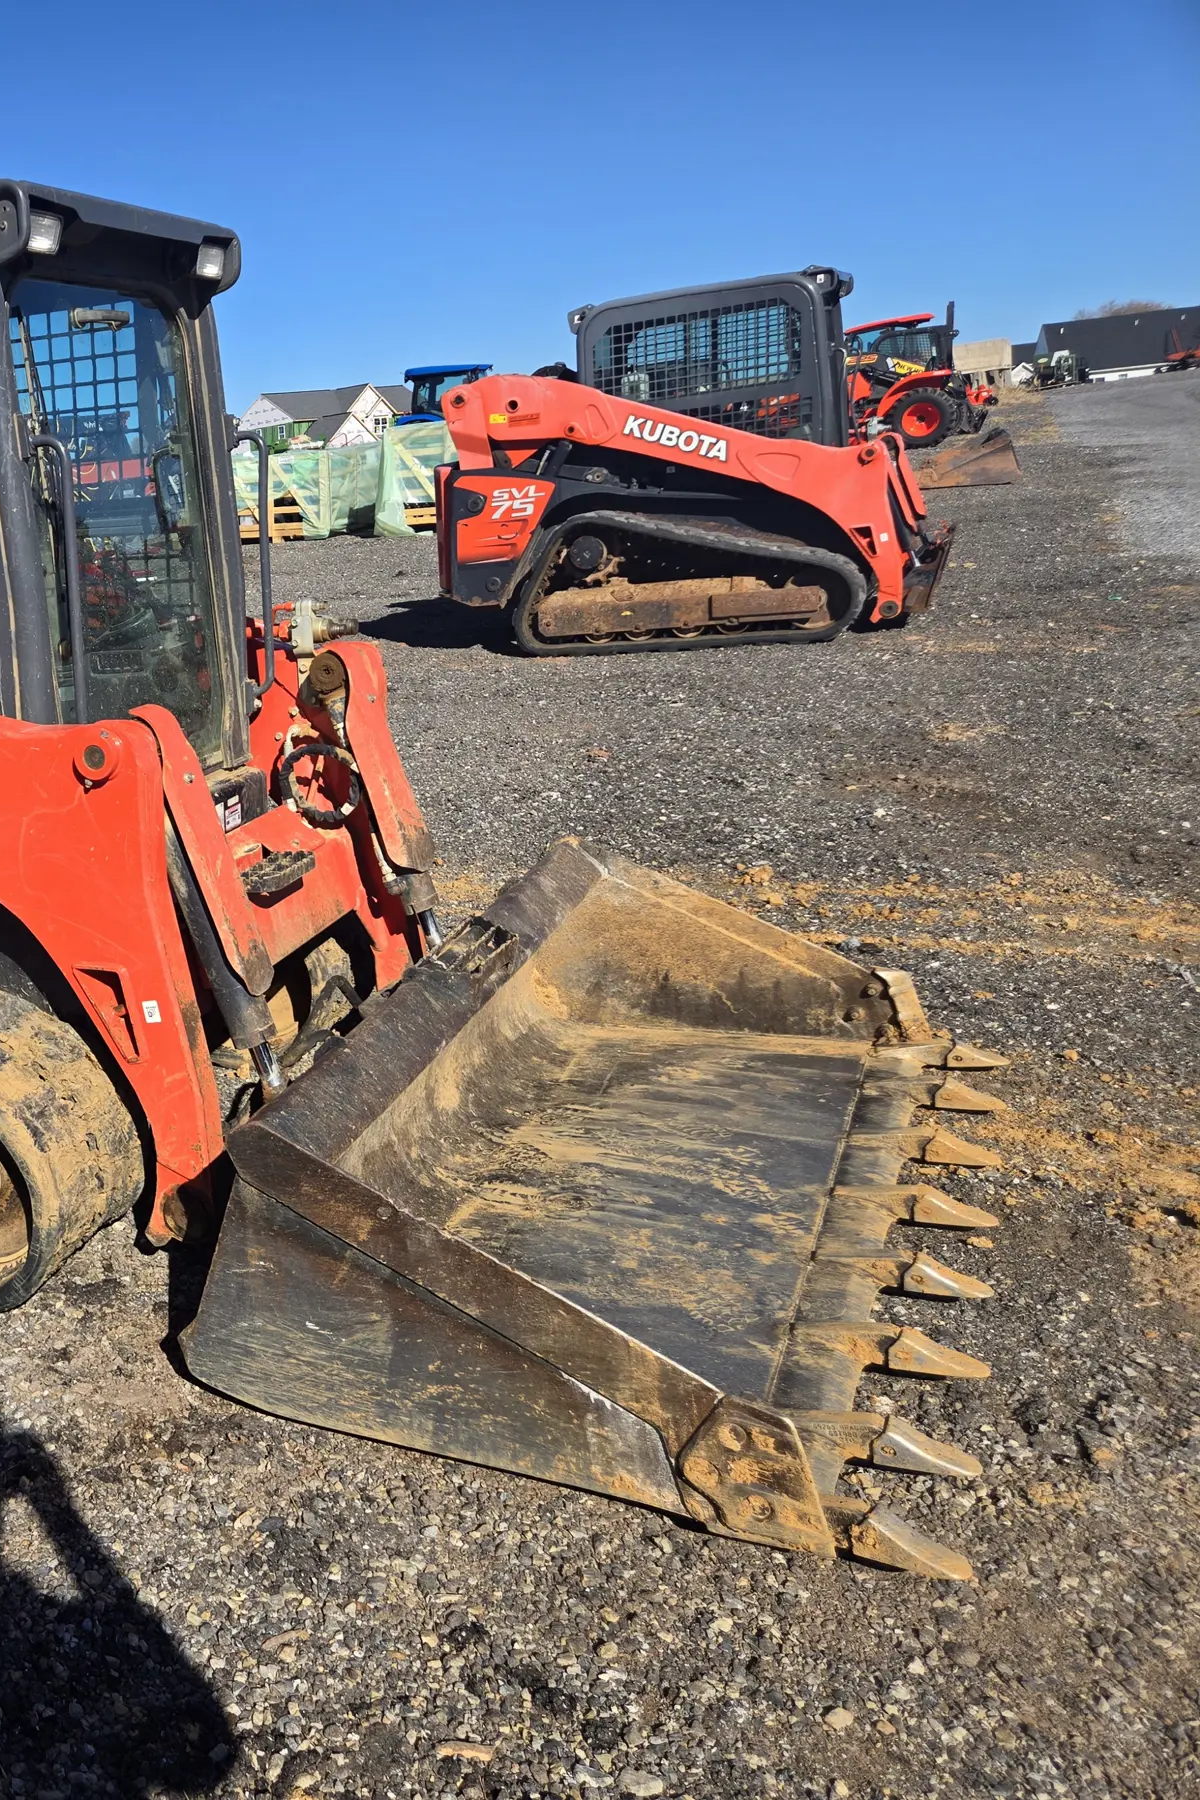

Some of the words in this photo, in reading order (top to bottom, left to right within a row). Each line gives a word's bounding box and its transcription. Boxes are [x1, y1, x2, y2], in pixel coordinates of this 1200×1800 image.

[623, 415, 727, 461] KUBOTA
[491, 485, 545, 501] SVL
[491, 497, 535, 520] 75
